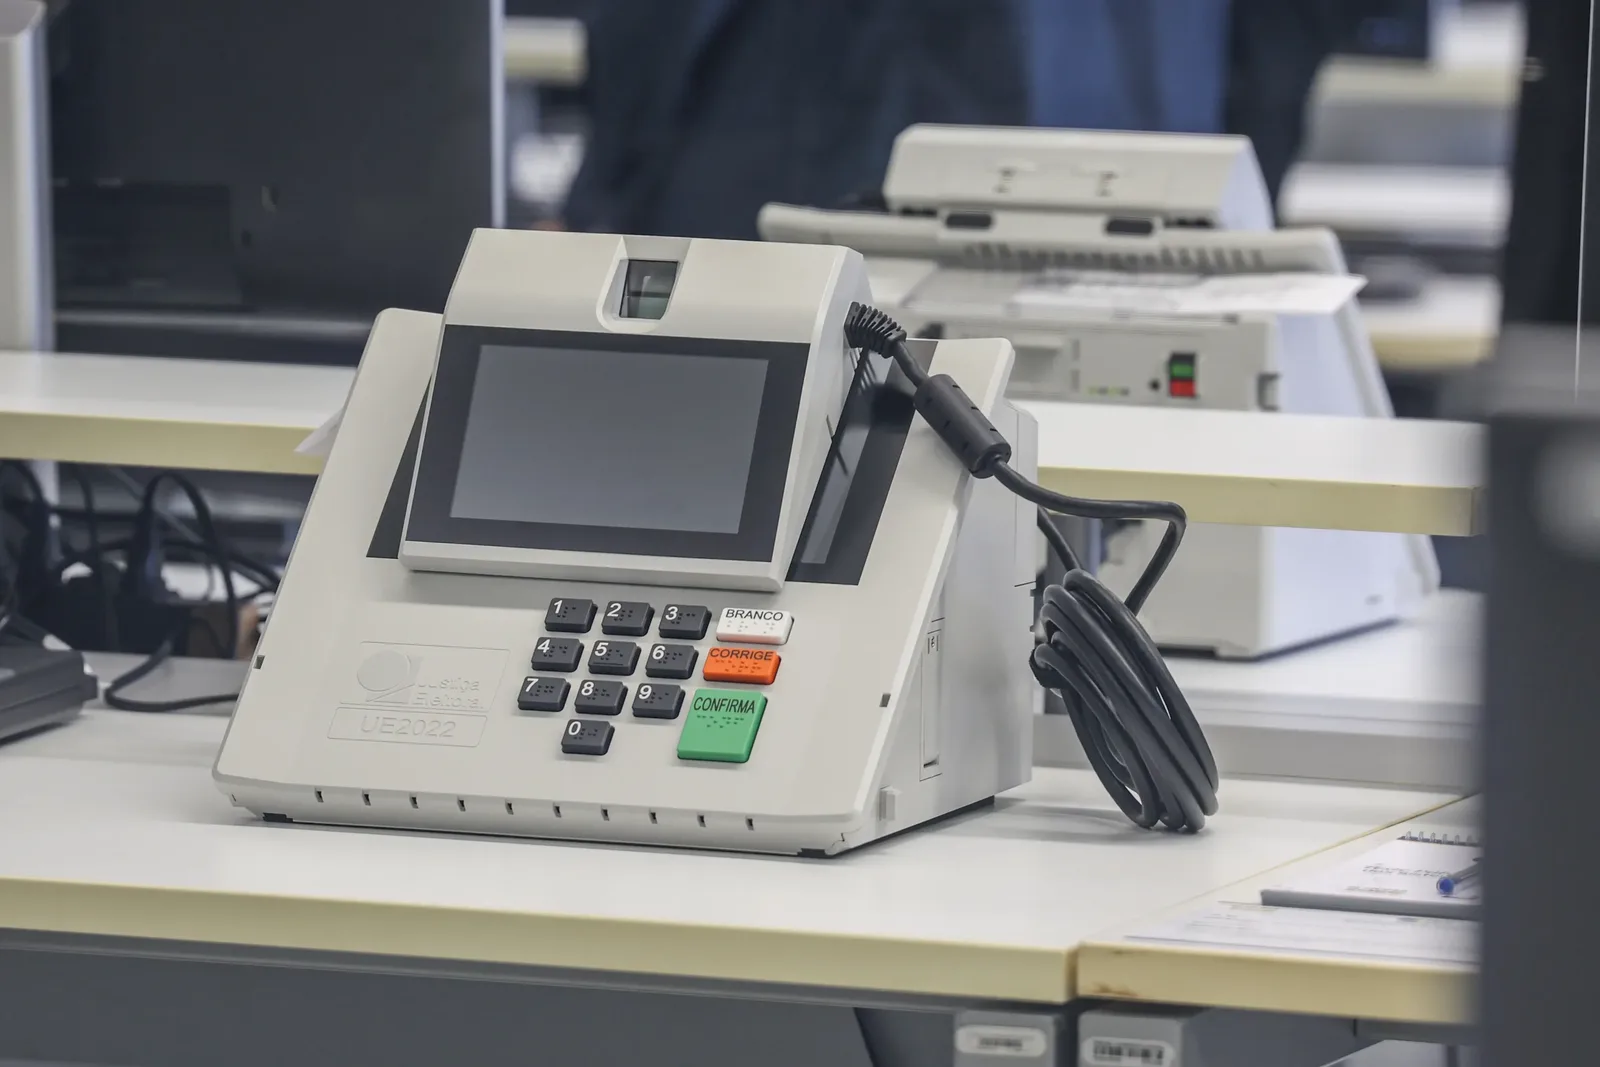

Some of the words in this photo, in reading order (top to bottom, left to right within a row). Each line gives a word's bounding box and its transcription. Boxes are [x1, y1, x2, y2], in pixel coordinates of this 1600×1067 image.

[554, 600, 563, 614] 1
[607, 603, 621, 617] 2
[665, 606, 678, 620] 3
[725, 609, 783, 621] BRANCO
[537, 639, 550, 653] 4
[595, 642, 608, 656] 5
[652, 645, 665, 660] 6
[710, 648, 774, 661] CORRIGE
[525, 678, 539, 692] 7
[581, 681, 595, 696] 8
[638, 685, 652, 699] 9
[694, 697, 755, 714] CONFIRMA
[361, 715, 457, 738] UE2022
[568, 721, 580, 735] 0
